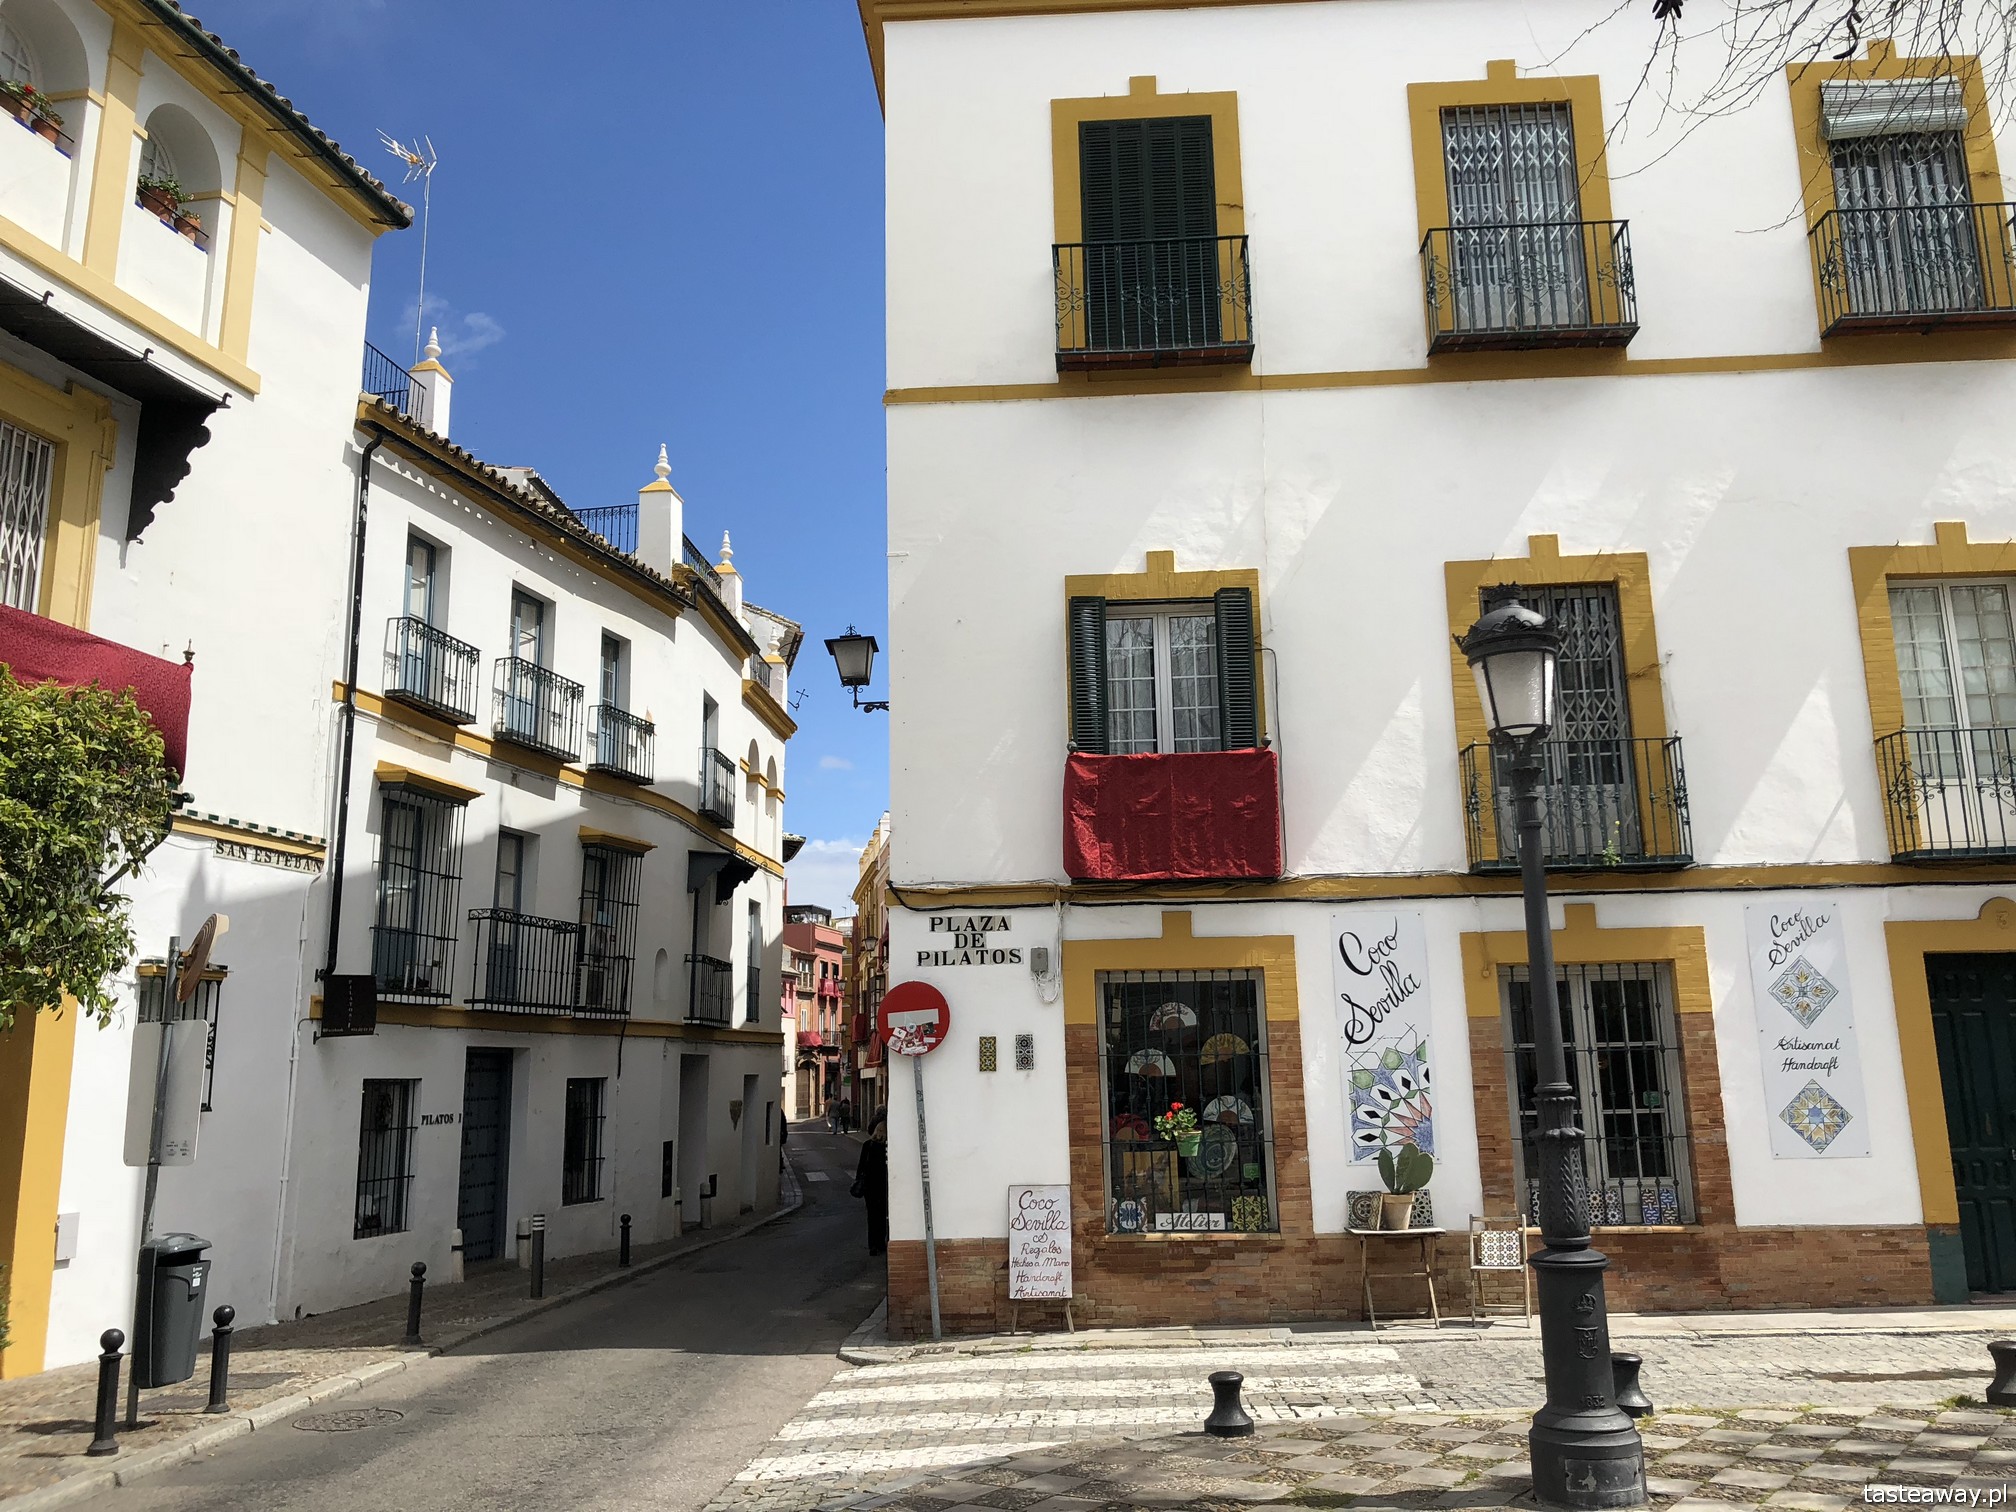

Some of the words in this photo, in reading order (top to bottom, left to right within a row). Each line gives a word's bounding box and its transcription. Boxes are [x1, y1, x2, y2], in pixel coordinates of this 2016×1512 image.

[215, 841, 248, 860] SAN
[254, 848, 324, 872] ESTEBAN
[930, 916, 1009, 931] PLAZA
[1770, 906, 1803, 938] Coco
[954, 933, 984, 948] DE
[1339, 916, 1398, 975] Coco
[1768, 914, 1831, 972] Sevilla
[917, 949, 1022, 966] PILATOS
[1340, 960, 1421, 1051] Sevilla
[1772, 1035, 1841, 1051] Artisanat
[1780, 1055, 1840, 1078] Handcraft
[420, 1113, 454, 1126] PILATOS
[1018, 1190, 1060, 1210] Coco
[1011, 1209, 1070, 1231] Sevilla
[1160, 1214, 1221, 1228] Atelier
[1021, 1240, 1062, 1259] Regalos
[1041, 1257, 1070, 1268] Mano
[1015, 1270, 1063, 1286] Handcraft
